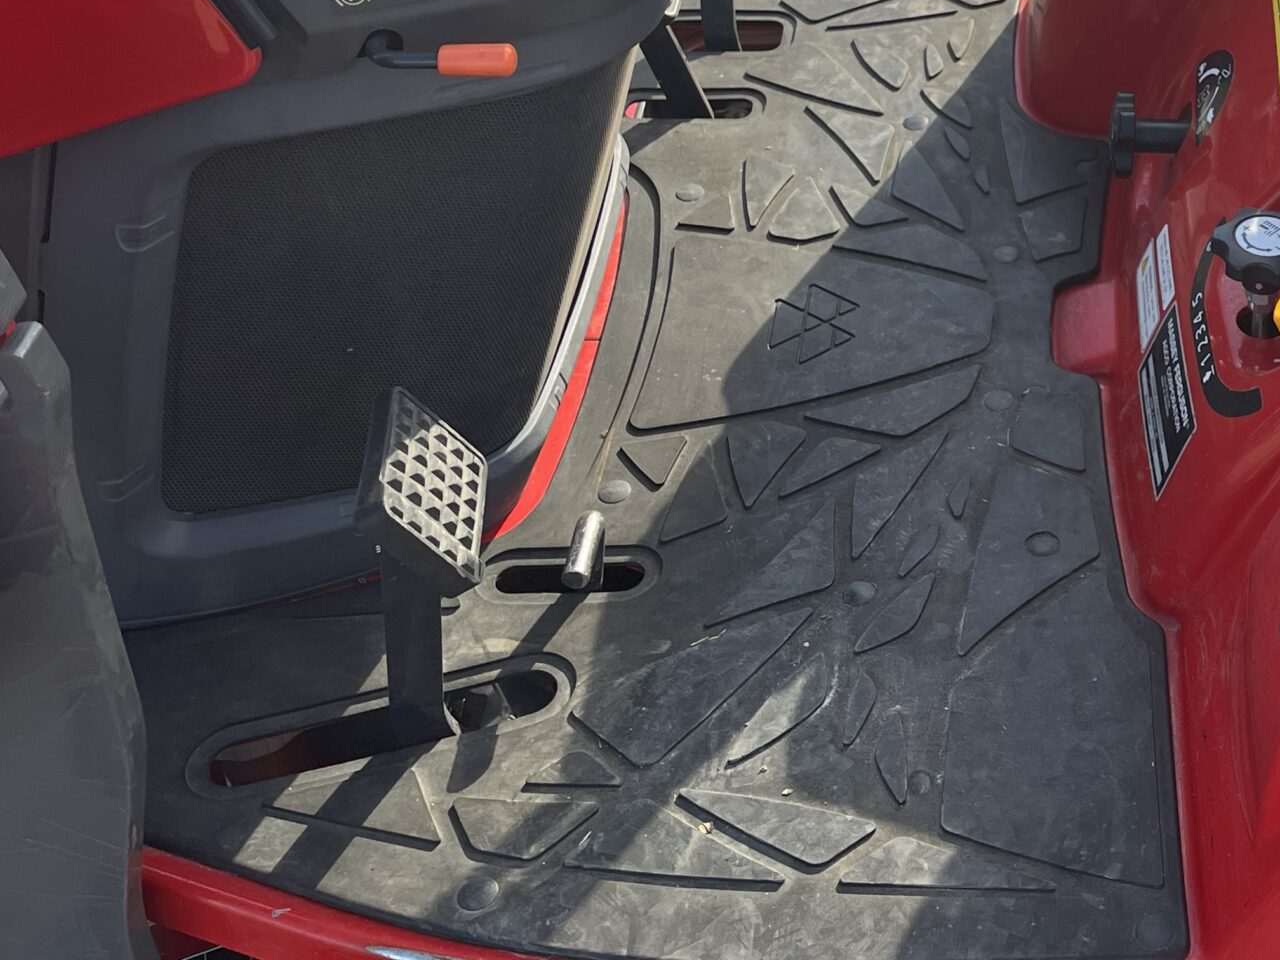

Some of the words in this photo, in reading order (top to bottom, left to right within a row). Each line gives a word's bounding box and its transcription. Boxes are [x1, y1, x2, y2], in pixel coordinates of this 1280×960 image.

[1167, 318, 1179, 364] MASSEY
[1162, 339, 1170, 366] AGCO
[1166, 365, 1181, 434] CORPORATION
